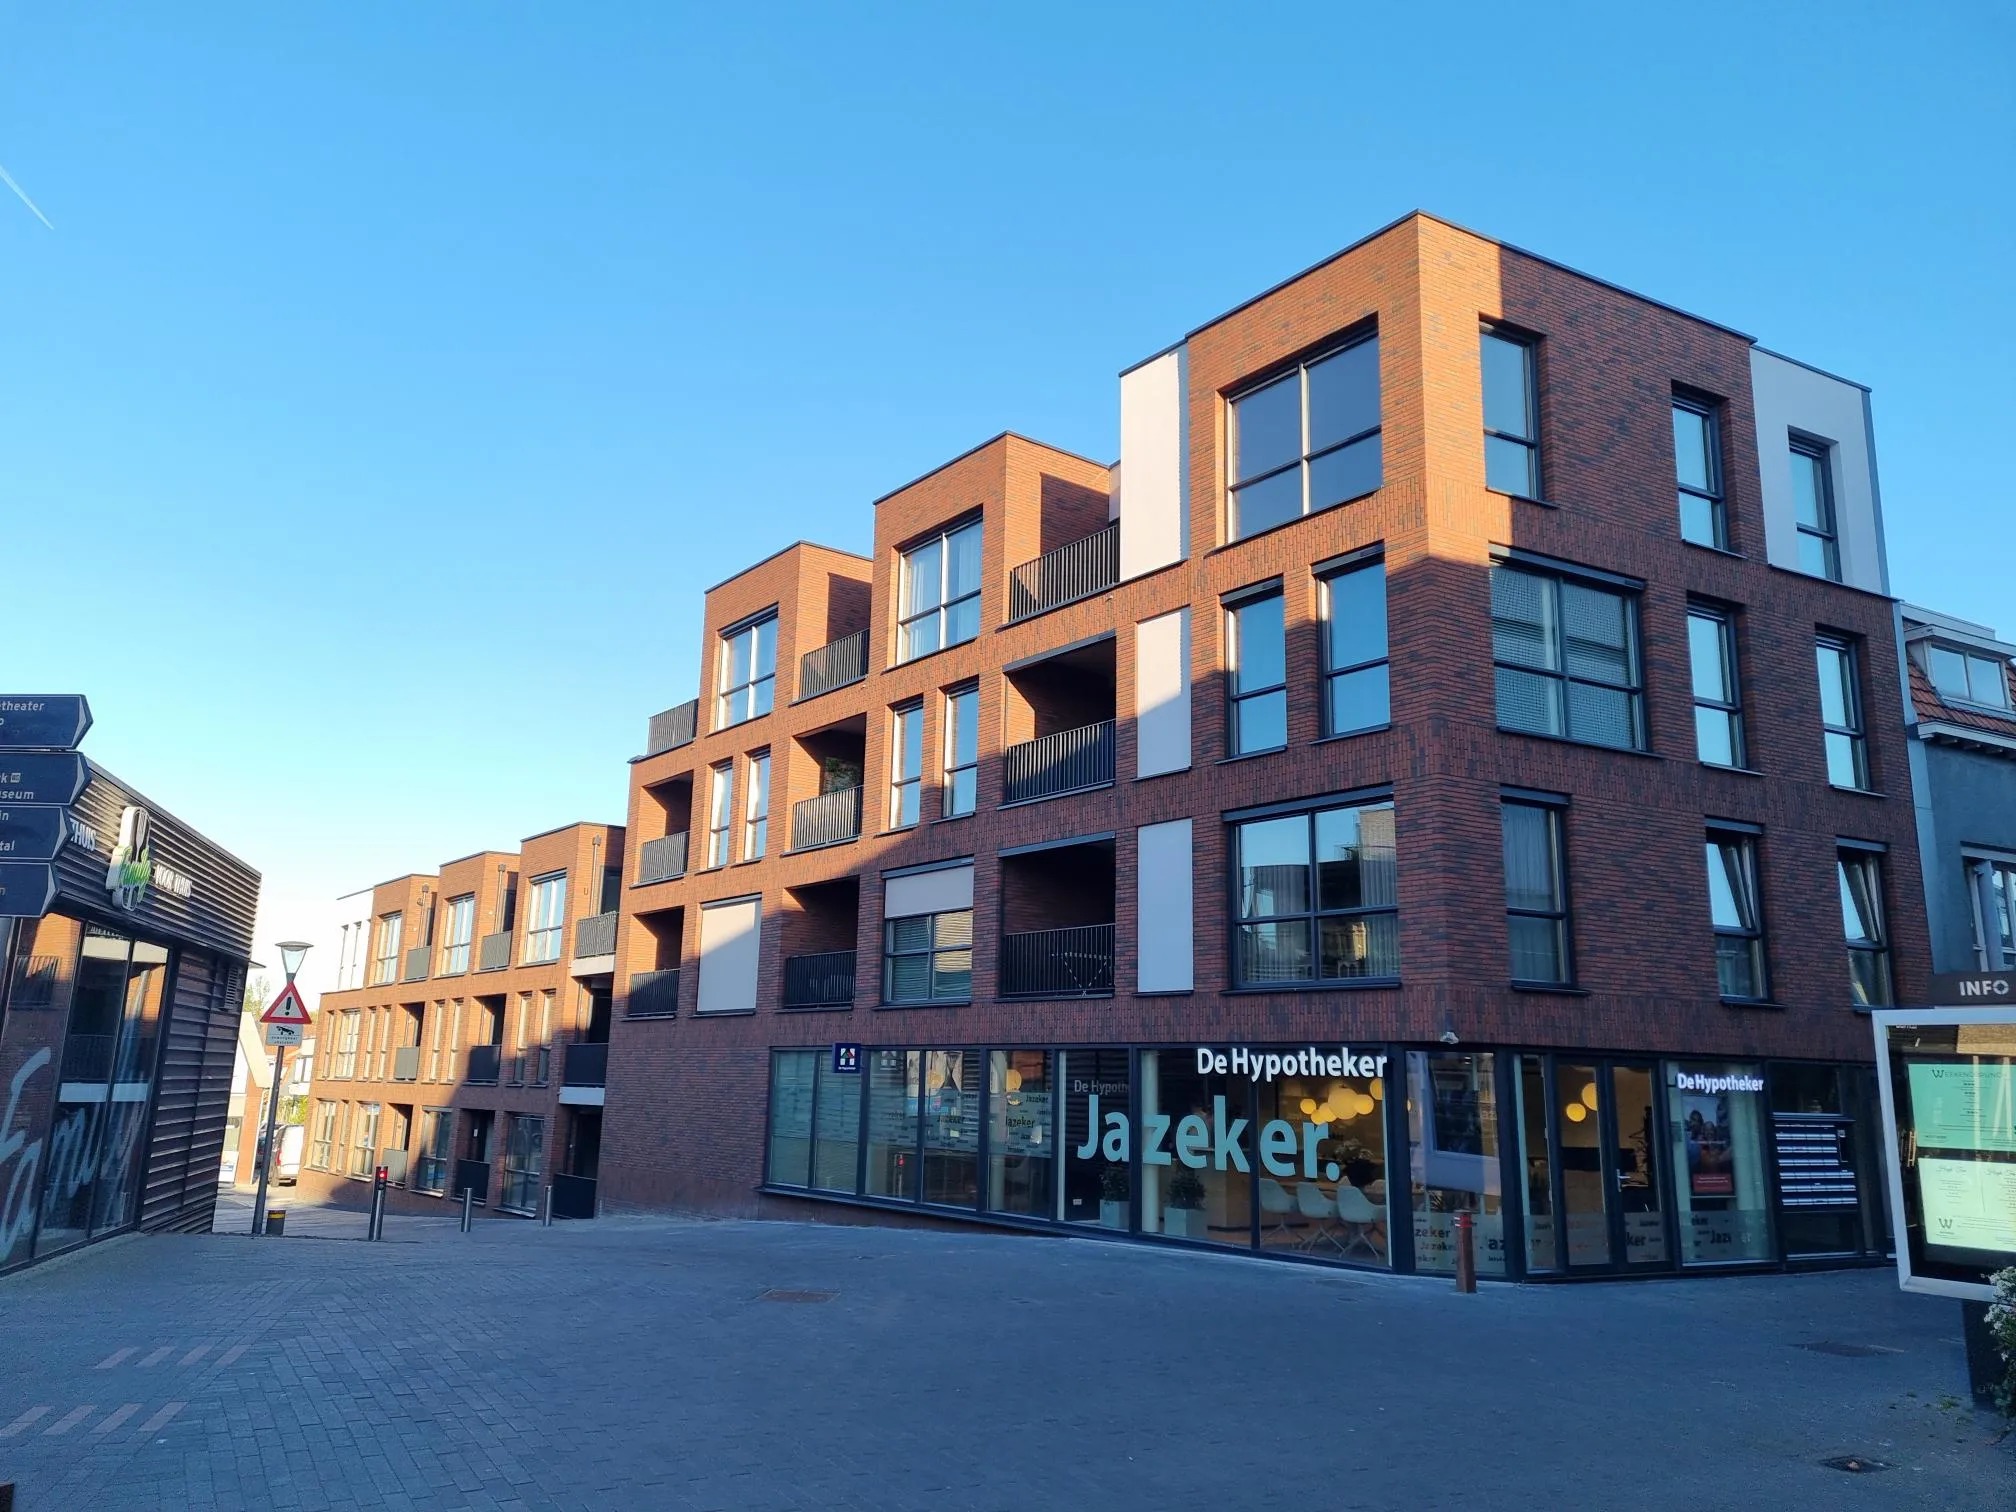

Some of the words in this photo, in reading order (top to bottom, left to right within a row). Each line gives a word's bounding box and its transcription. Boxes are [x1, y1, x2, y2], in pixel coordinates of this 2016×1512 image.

[0, 700, 45, 711] theater
[1959, 979, 2009, 996] INFO
[1231, 1046, 1388, 1083] Hypotheker
[1074, 1079, 1088, 1093] De
[1091, 1079, 1130, 1096] Hypoth
[1694, 1074, 1764, 1094] Hypotheker
